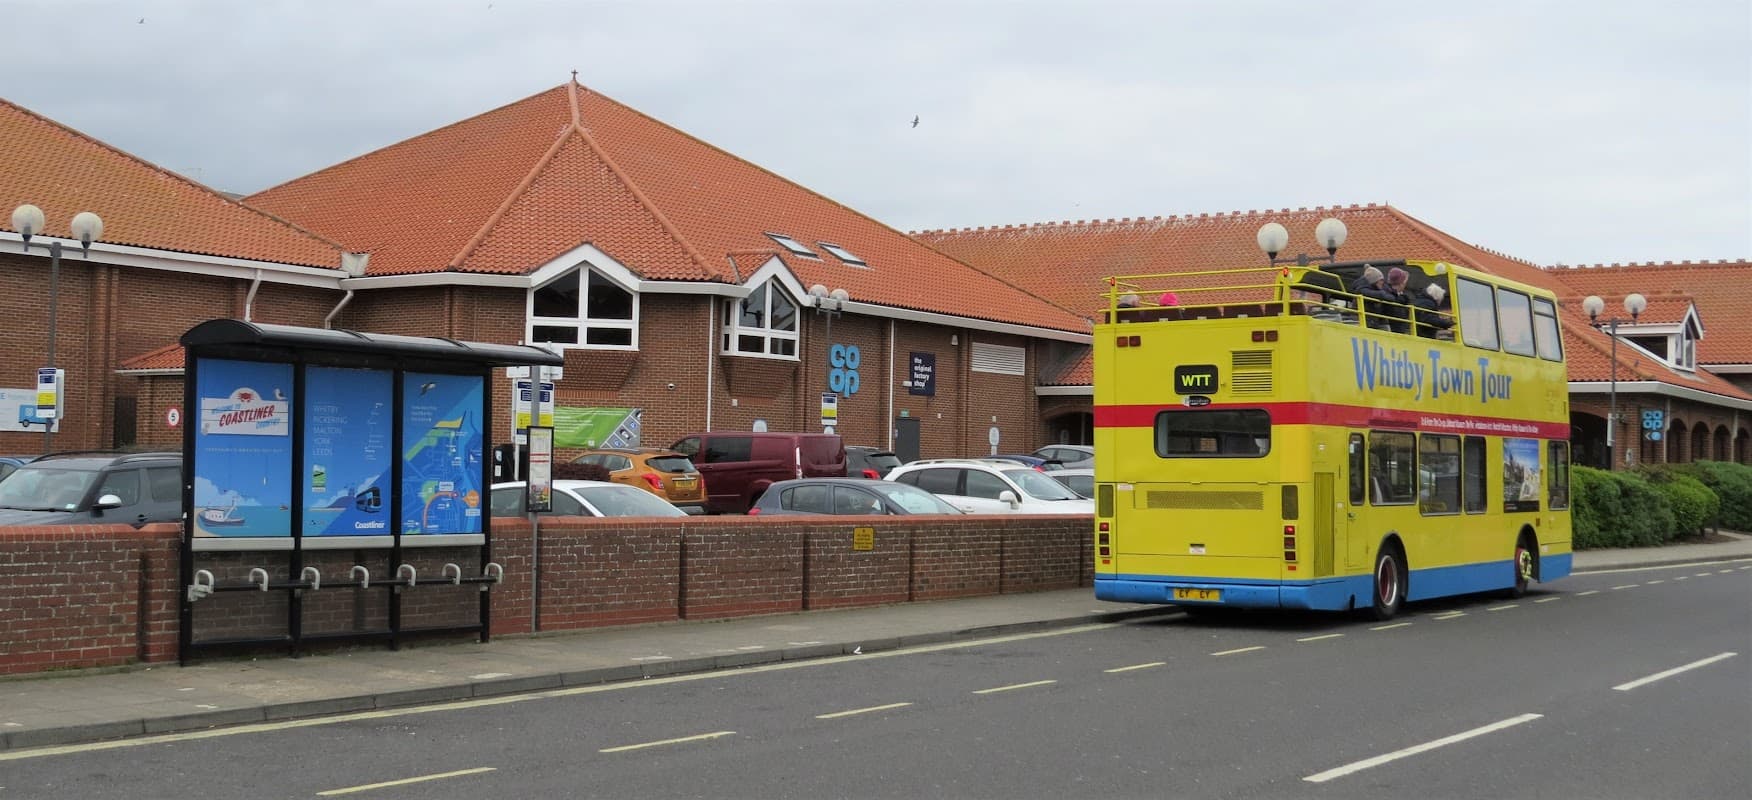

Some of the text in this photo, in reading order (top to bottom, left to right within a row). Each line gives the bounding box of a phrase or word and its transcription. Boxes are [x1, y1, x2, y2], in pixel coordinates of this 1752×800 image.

[914, 364, 932, 373] original
[1351, 337, 1512, 403] Whitby Town Tour
[914, 372, 930, 382] factory
[1181, 374, 1211, 387] WTT
[914, 380, 926, 389] shop
[170, 410, 177, 423] 5
[219, 404, 276, 428] COASTLINER
[354, 520, 386, 530] Coastliner
